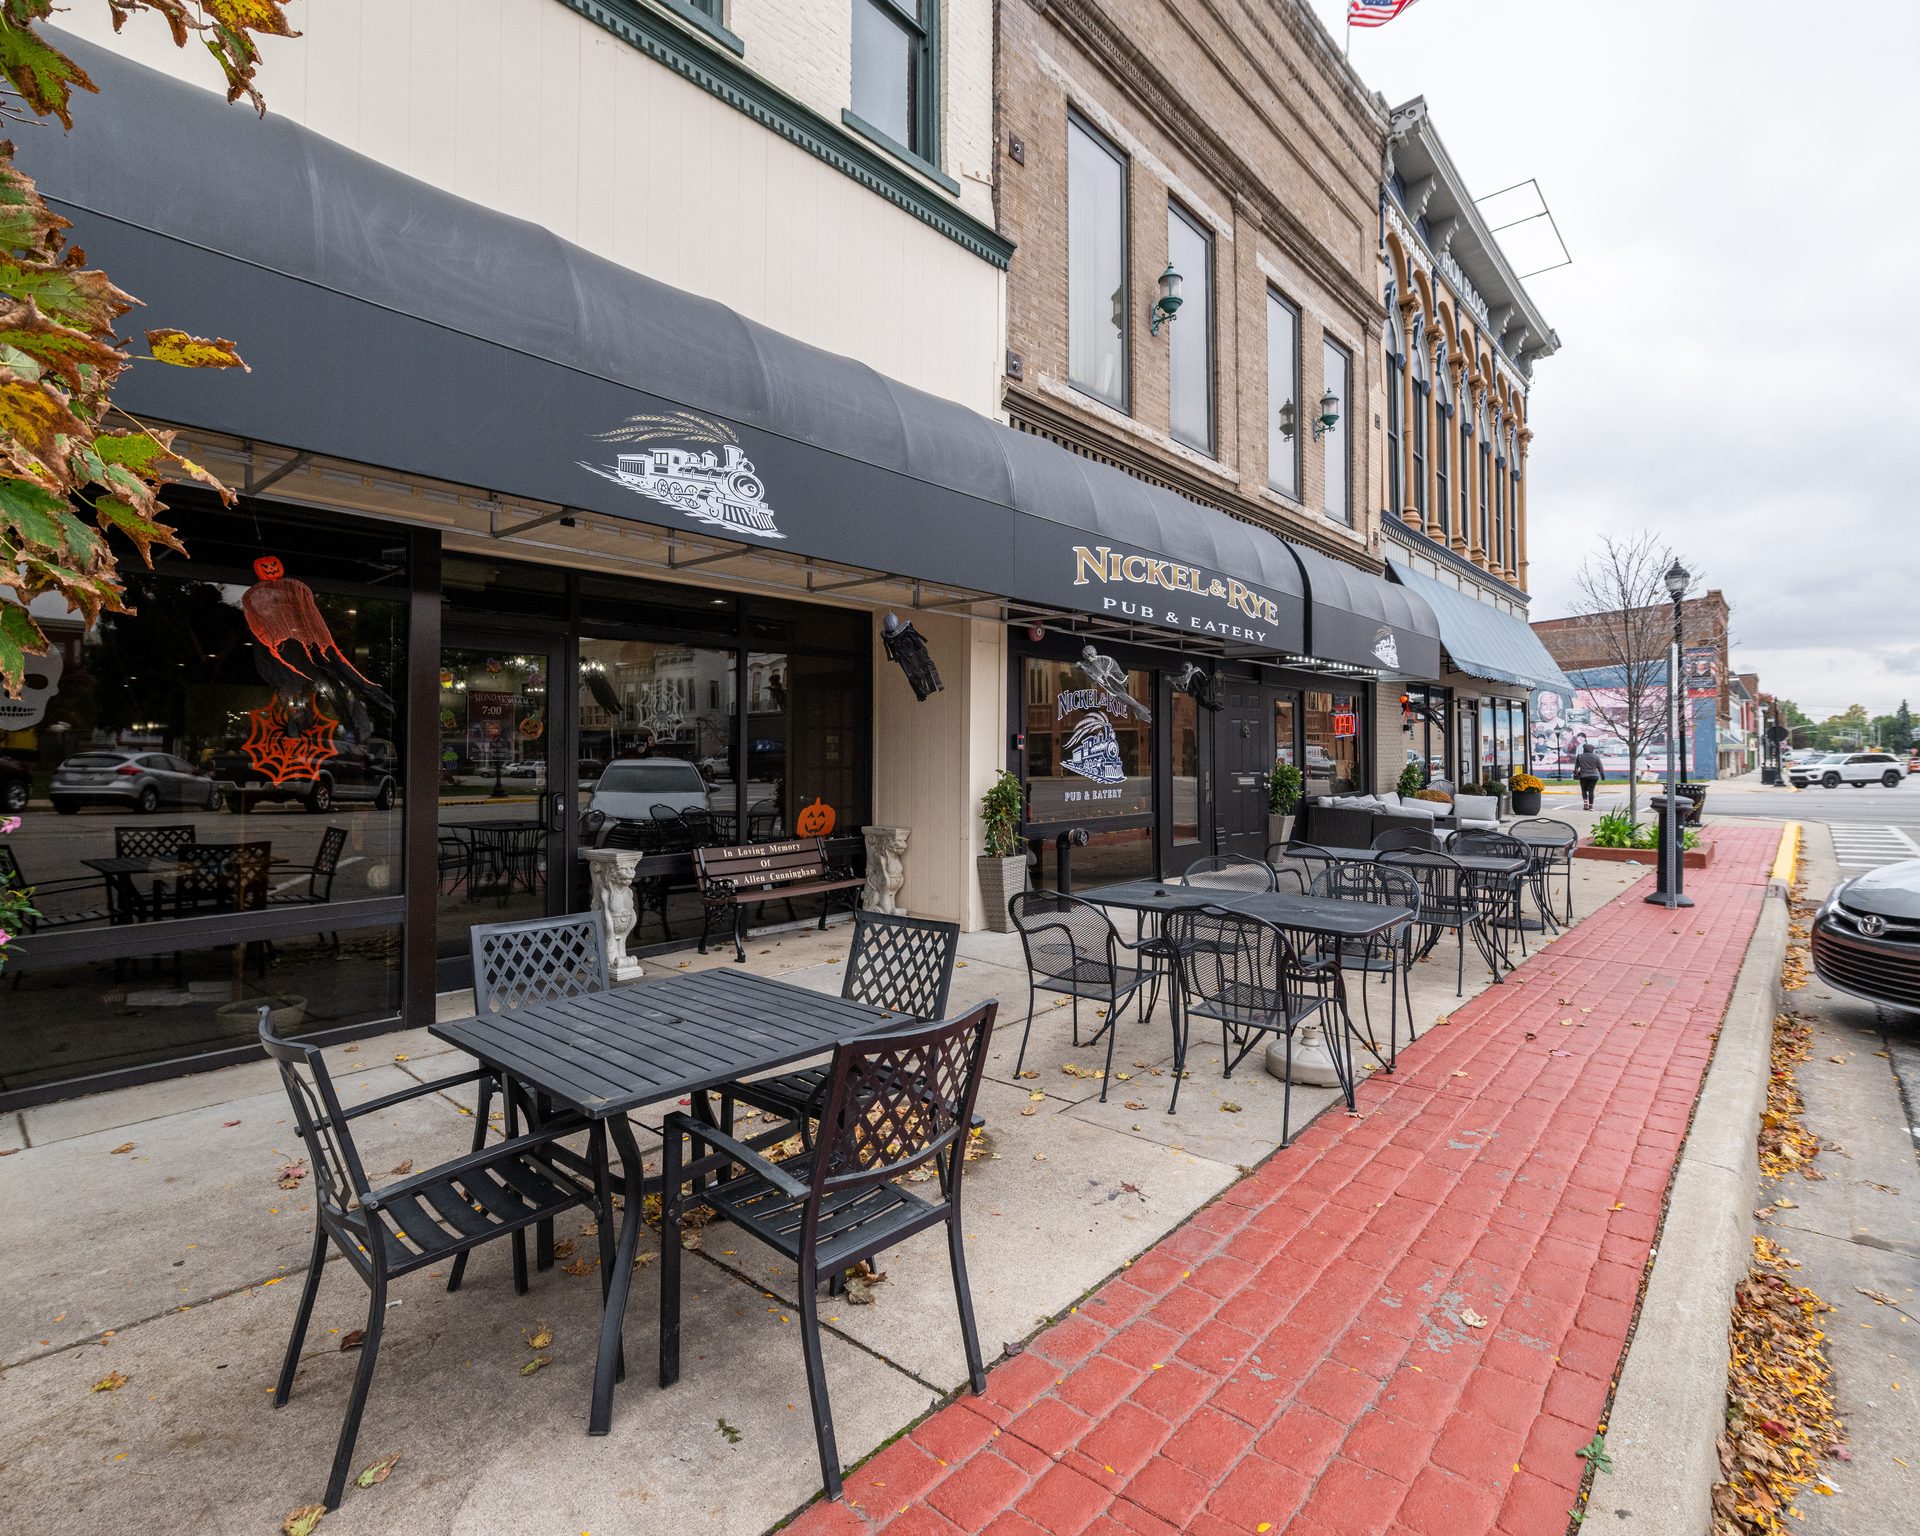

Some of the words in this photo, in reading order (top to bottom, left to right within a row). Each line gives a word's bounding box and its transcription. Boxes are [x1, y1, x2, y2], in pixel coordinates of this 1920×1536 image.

[1103, 597, 1154, 618] PUB
[1165, 611, 1180, 624] &
[1190, 616, 1267, 642] EATERY
[481, 705, 502, 715] 7:00
[1064, 791, 1081, 801] PUB
[1083, 790, 1090, 800] &
[1092, 788, 1123, 799] EATERY
[723, 849, 733, 858] In
[737, 846, 766, 857] Loving
[769, 843, 801, 853] Memory
[760, 859, 771, 868] Of
[743, 875, 766, 885] Allen
[769, 867, 817, 881] Cunningham
